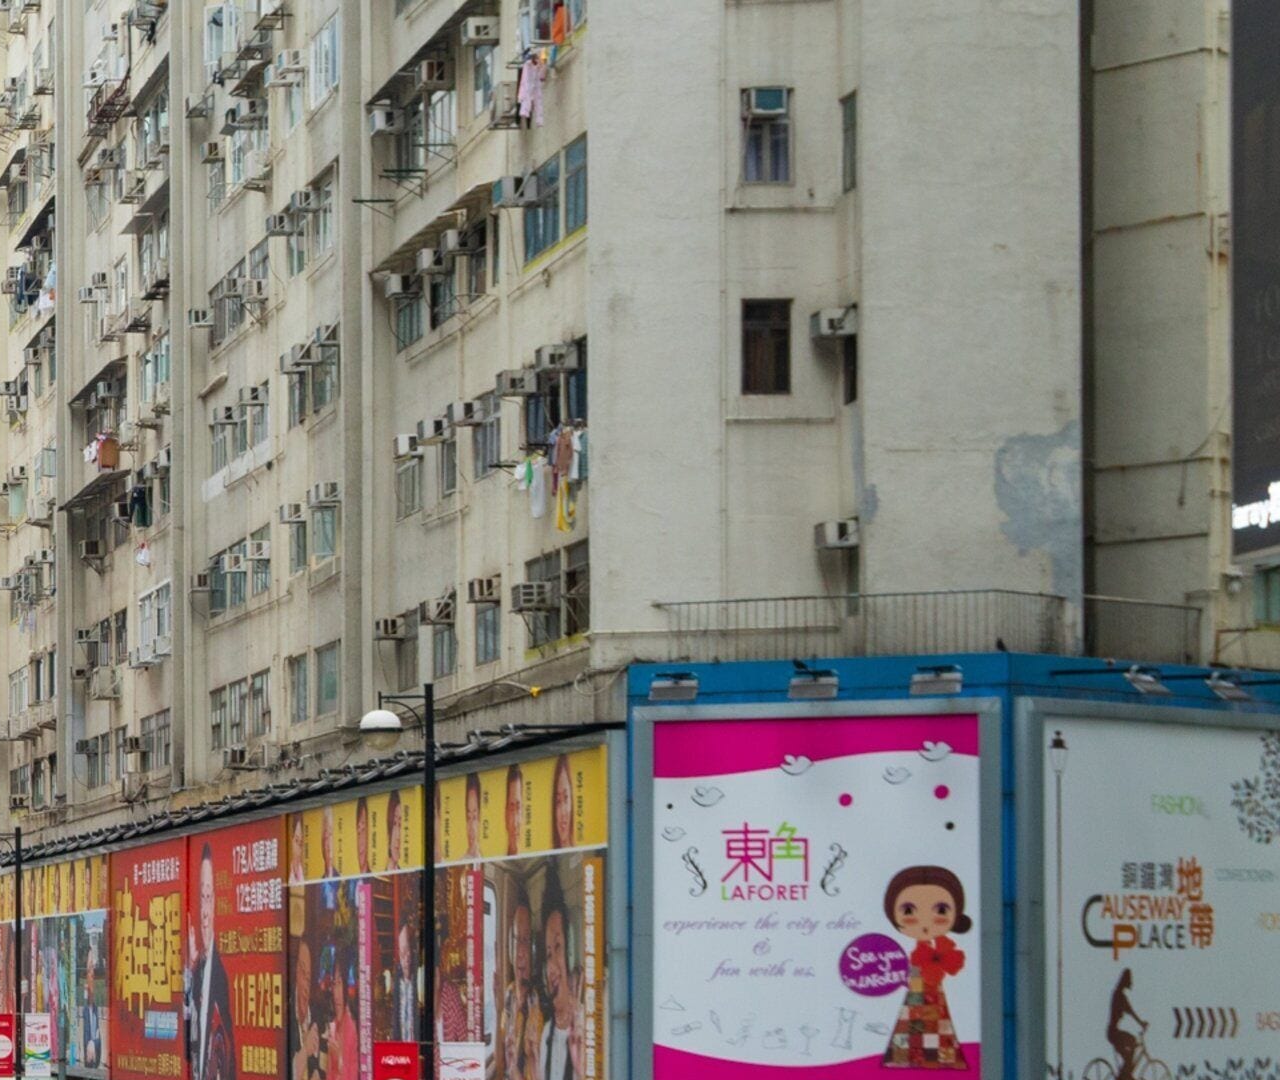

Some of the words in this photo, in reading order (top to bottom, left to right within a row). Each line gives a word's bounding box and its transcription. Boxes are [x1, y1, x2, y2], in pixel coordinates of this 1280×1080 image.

[721, 821, 810, 884] 東角
[721, 884, 810, 901] LAFORET
[662, 916, 748, 936] experience
[753, 912, 781, 930] the
[786, 917, 820, 936] city
[1112, 923, 1187, 961] PLACE
[747, 958, 787, 978] with
[234, 971, 284, 1030] 11月23日
